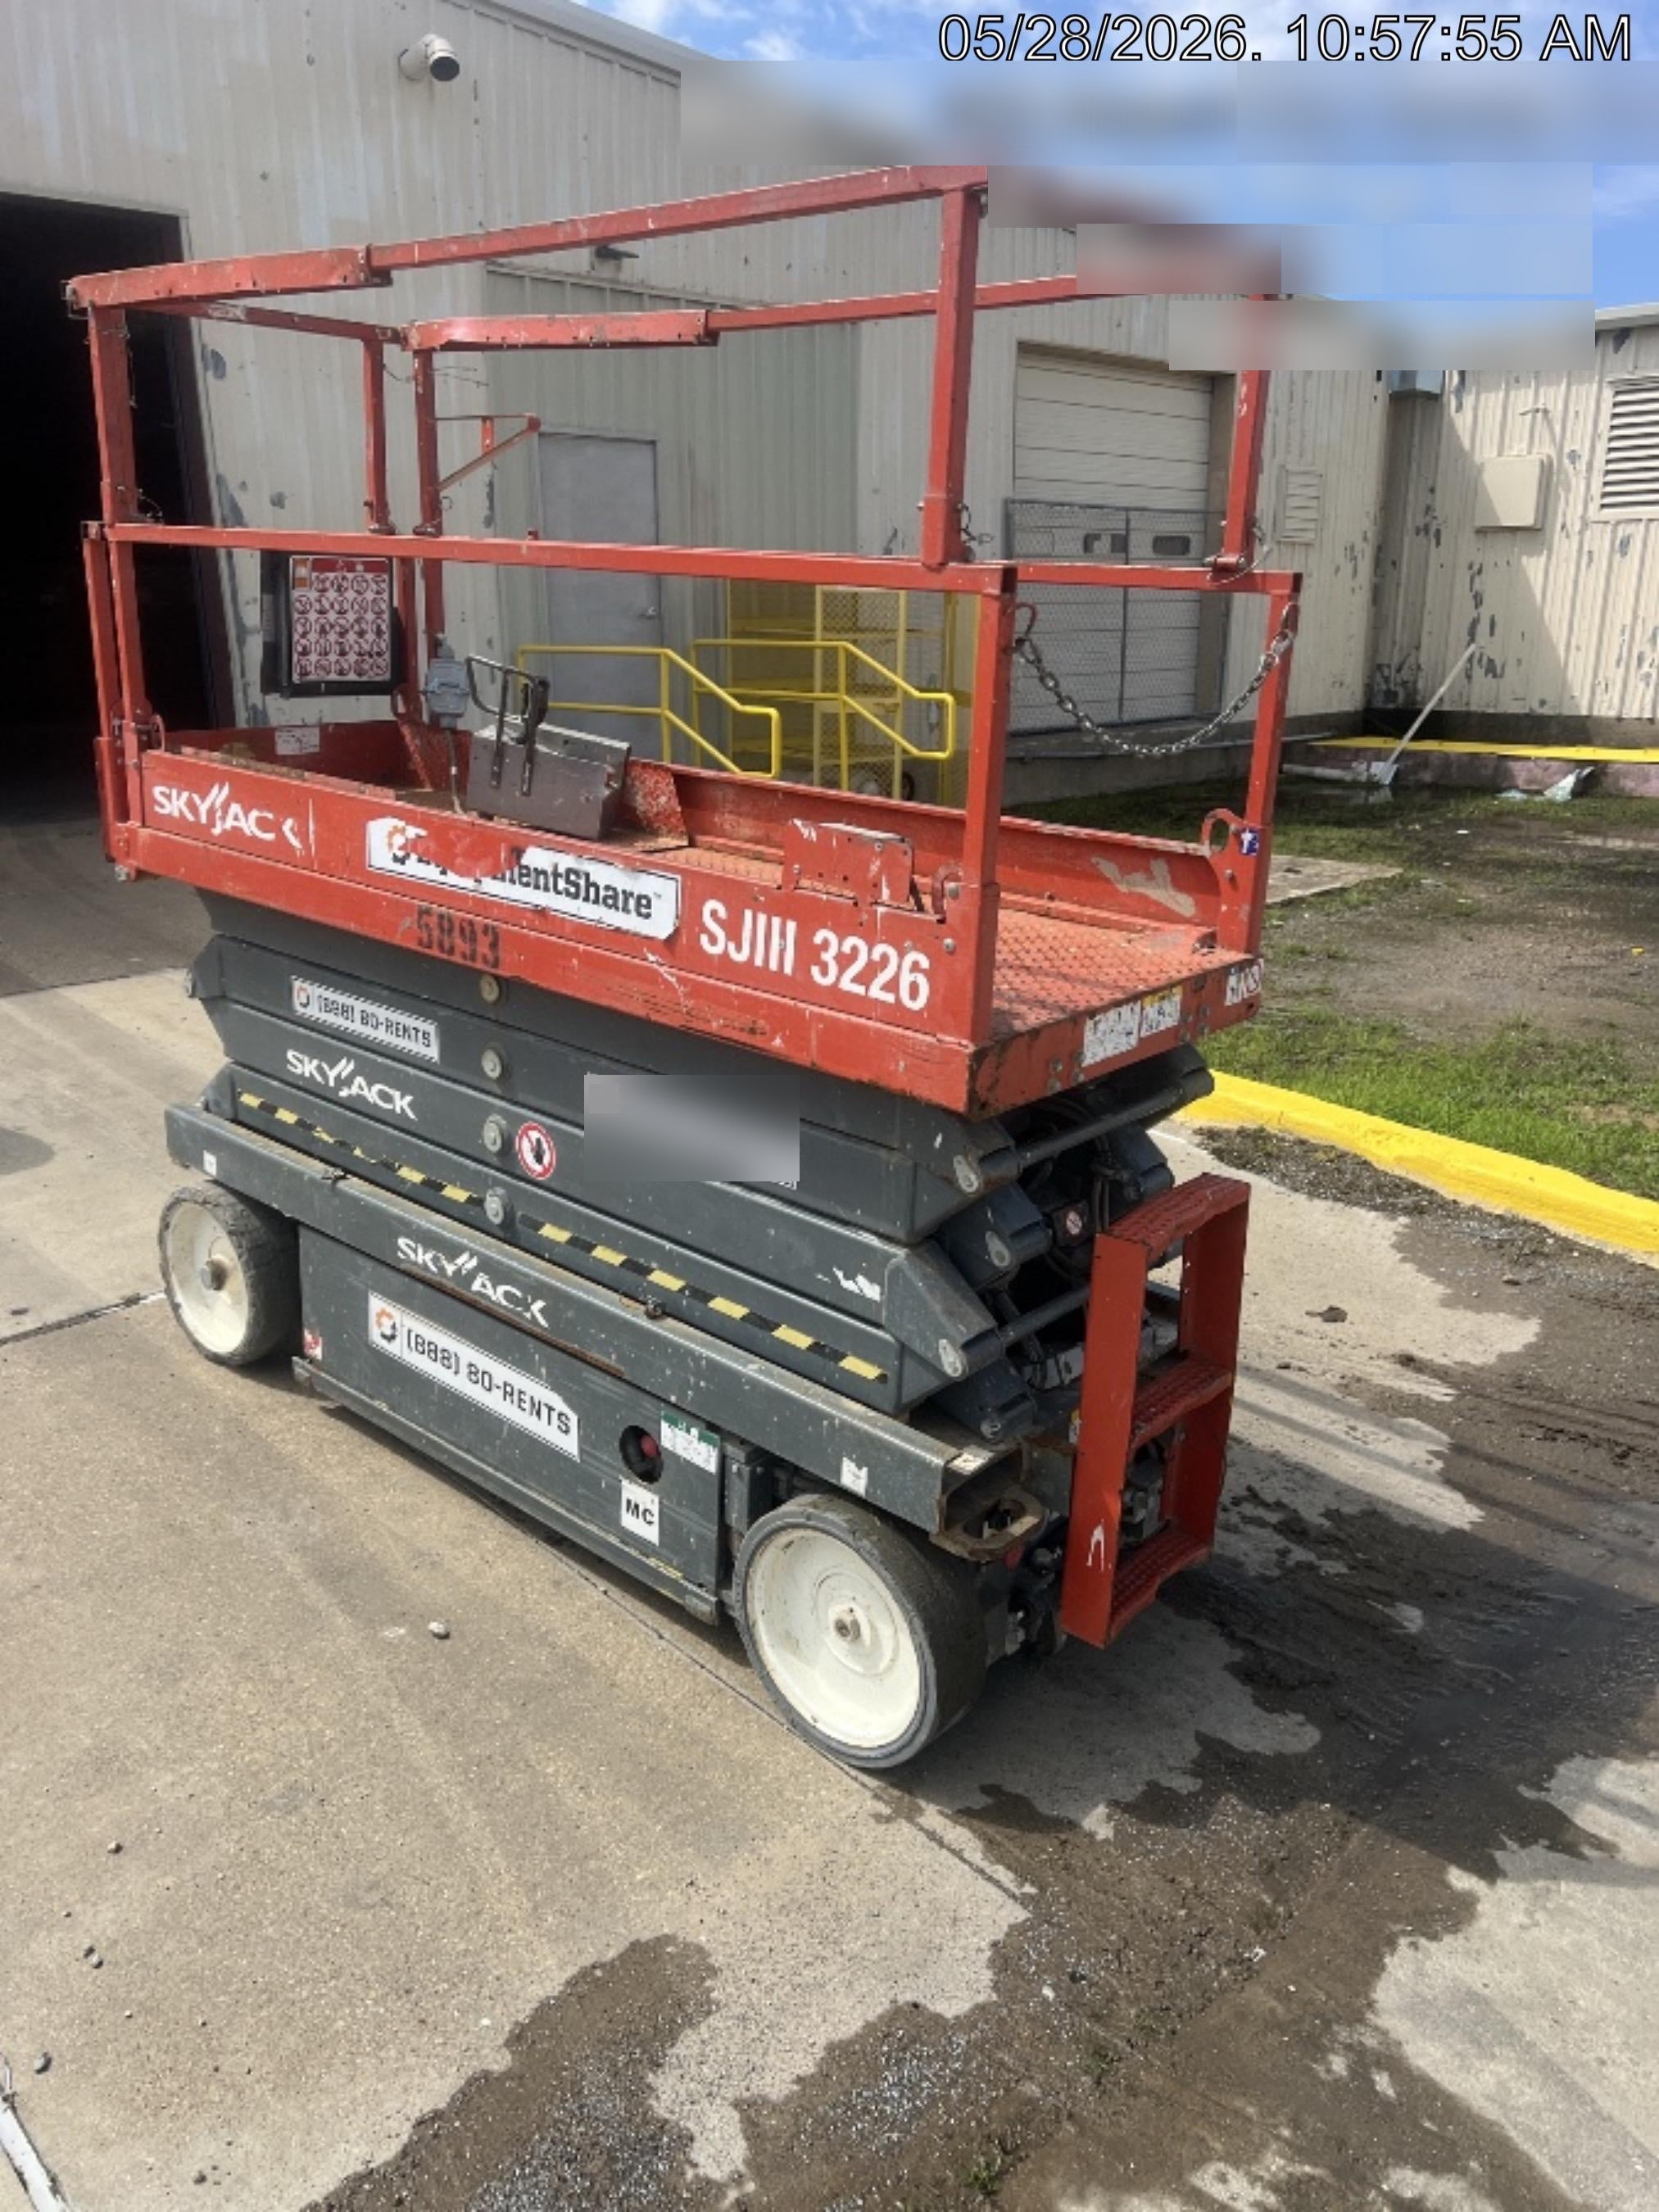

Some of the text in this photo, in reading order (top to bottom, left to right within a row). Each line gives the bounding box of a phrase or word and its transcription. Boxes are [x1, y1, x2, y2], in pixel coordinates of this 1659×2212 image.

[416, 833, 653, 920] entShare
[418, 904, 500, 968] 5893
[811, 928, 930, 1011] 3226
[466, 1361, 571, 1435] 80-RENTS
[626, 1498, 655, 1526] MC
